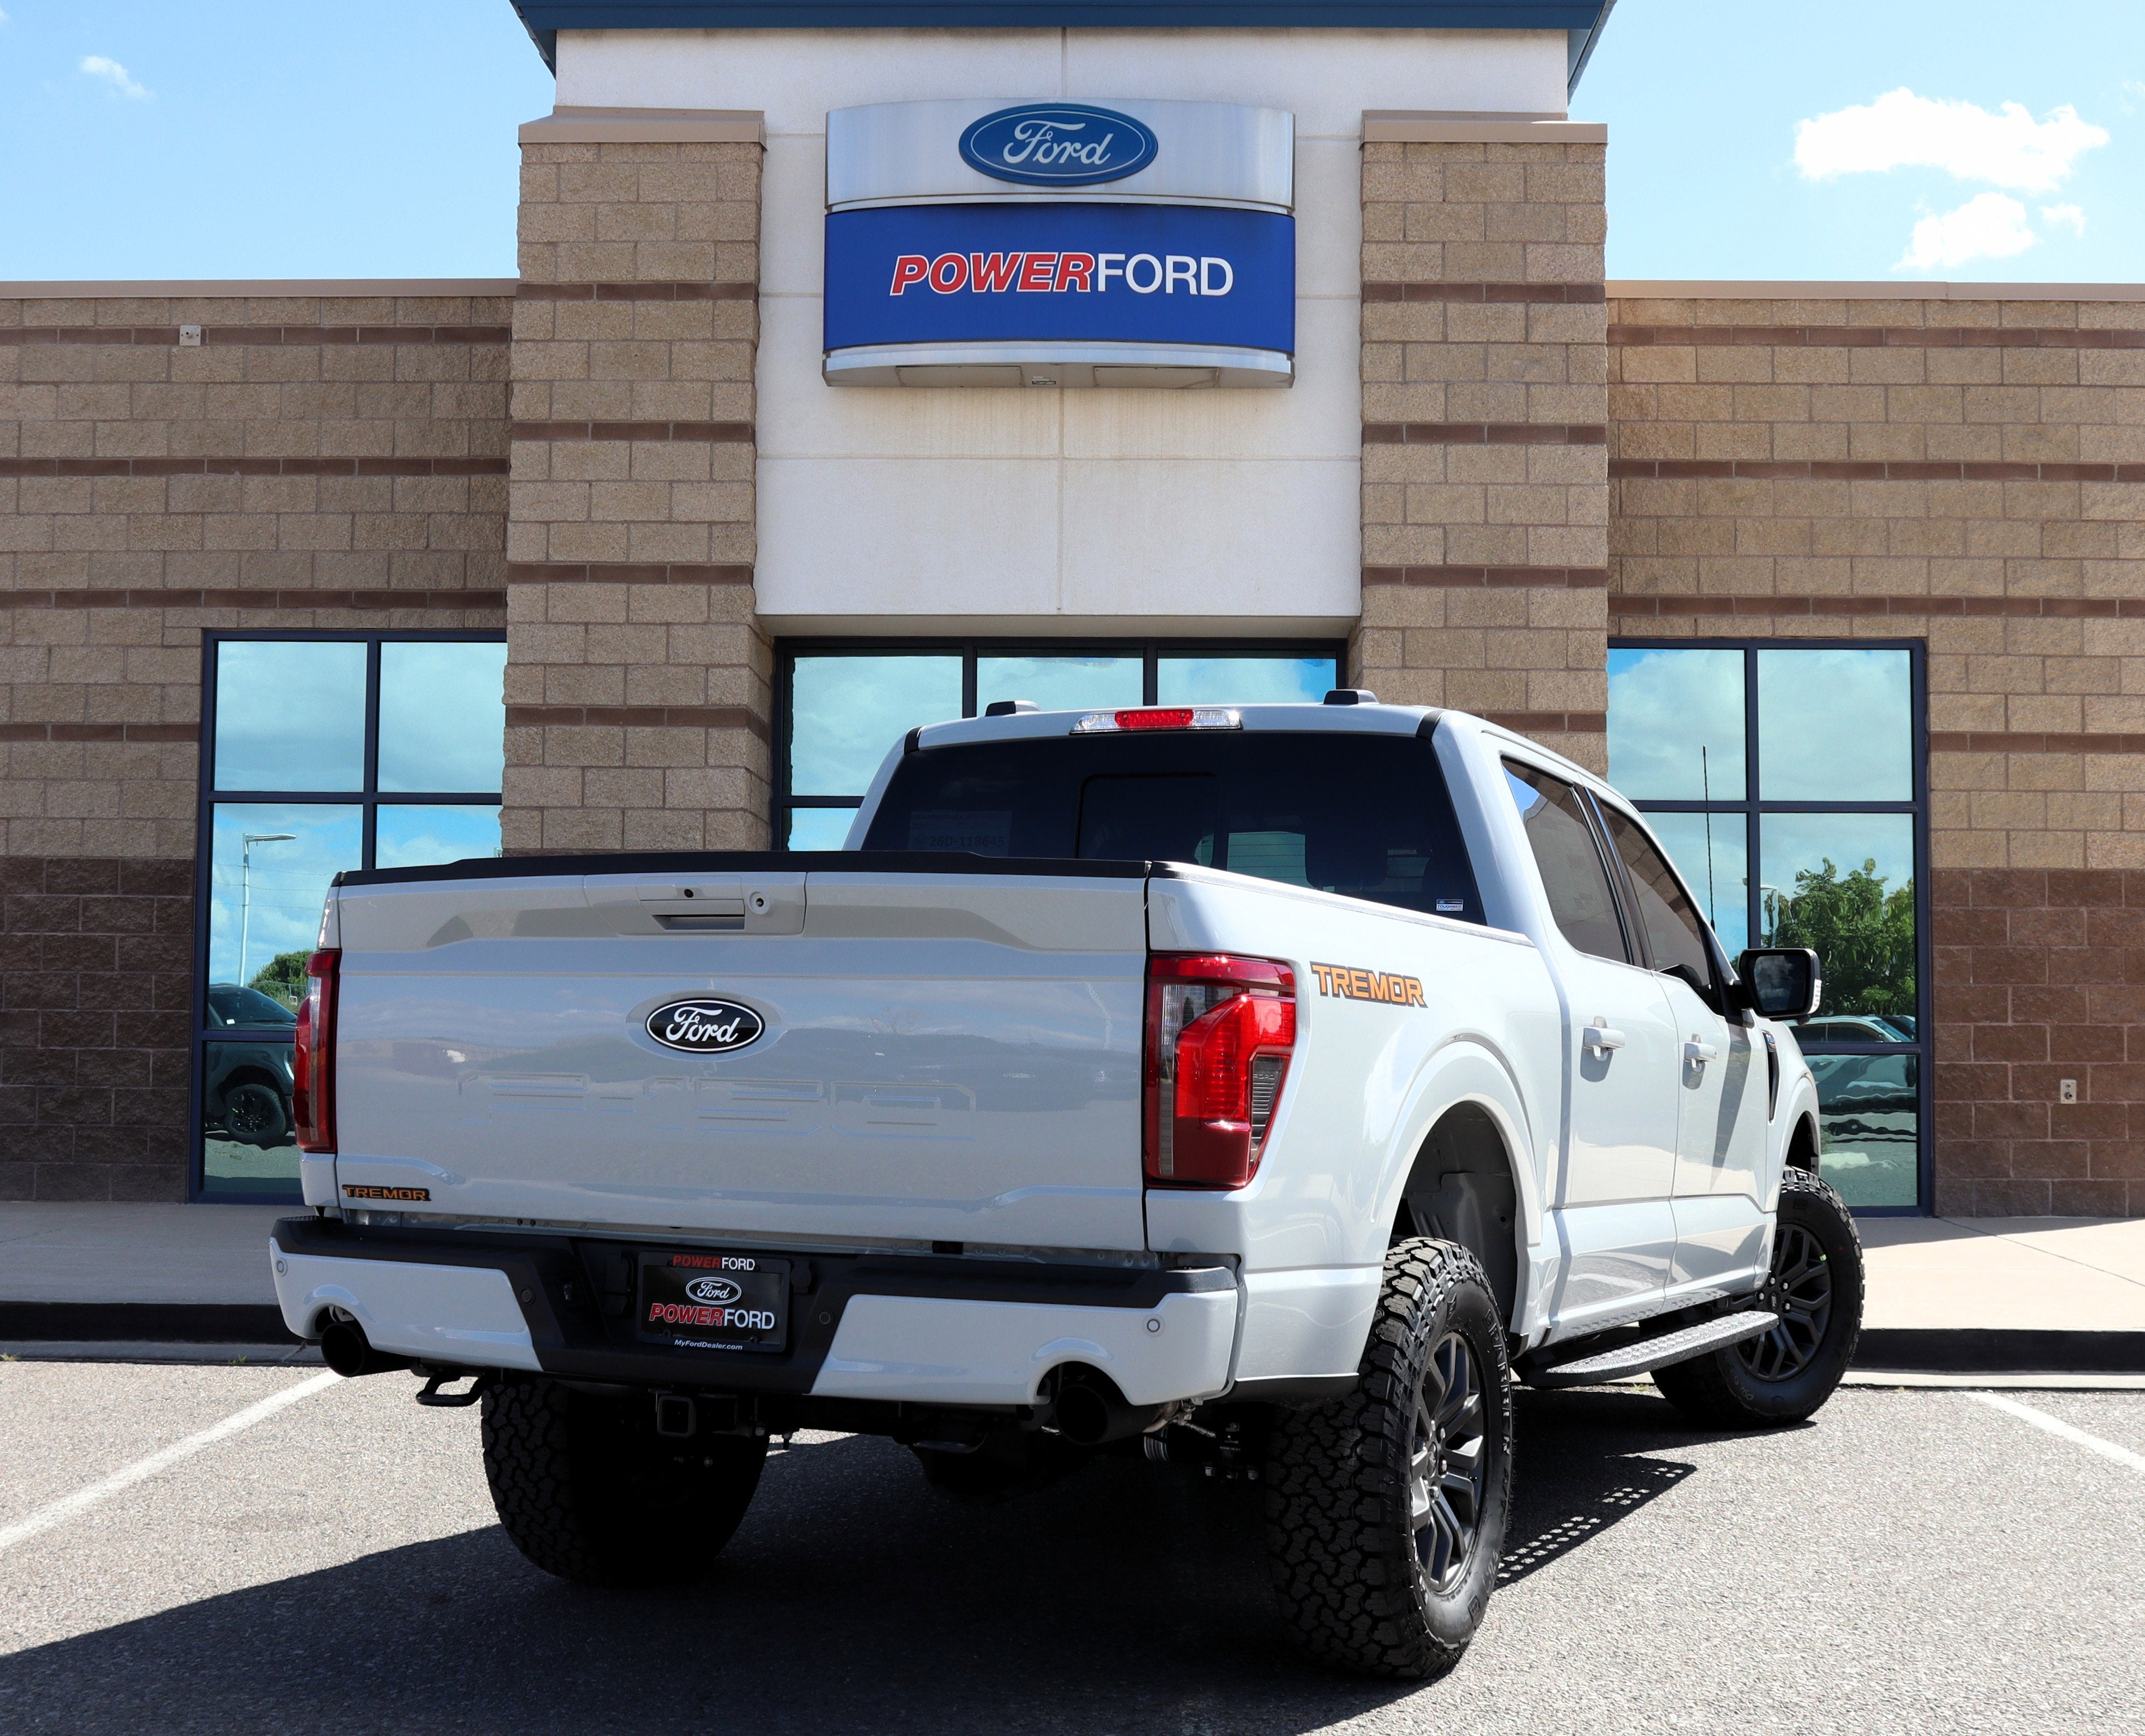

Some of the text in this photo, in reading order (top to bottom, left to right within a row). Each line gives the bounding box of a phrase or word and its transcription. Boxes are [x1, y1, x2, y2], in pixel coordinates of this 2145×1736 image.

[1003, 119, 1114, 165] Ford
[1309, 961, 1429, 1009] TREMOR
[665, 1006, 741, 1043] Ford
[342, 1184, 432, 1202] TREMOR
[697, 1281, 730, 1299] Ford
[674, 1339, 743, 1351] MyFordDealer.com
